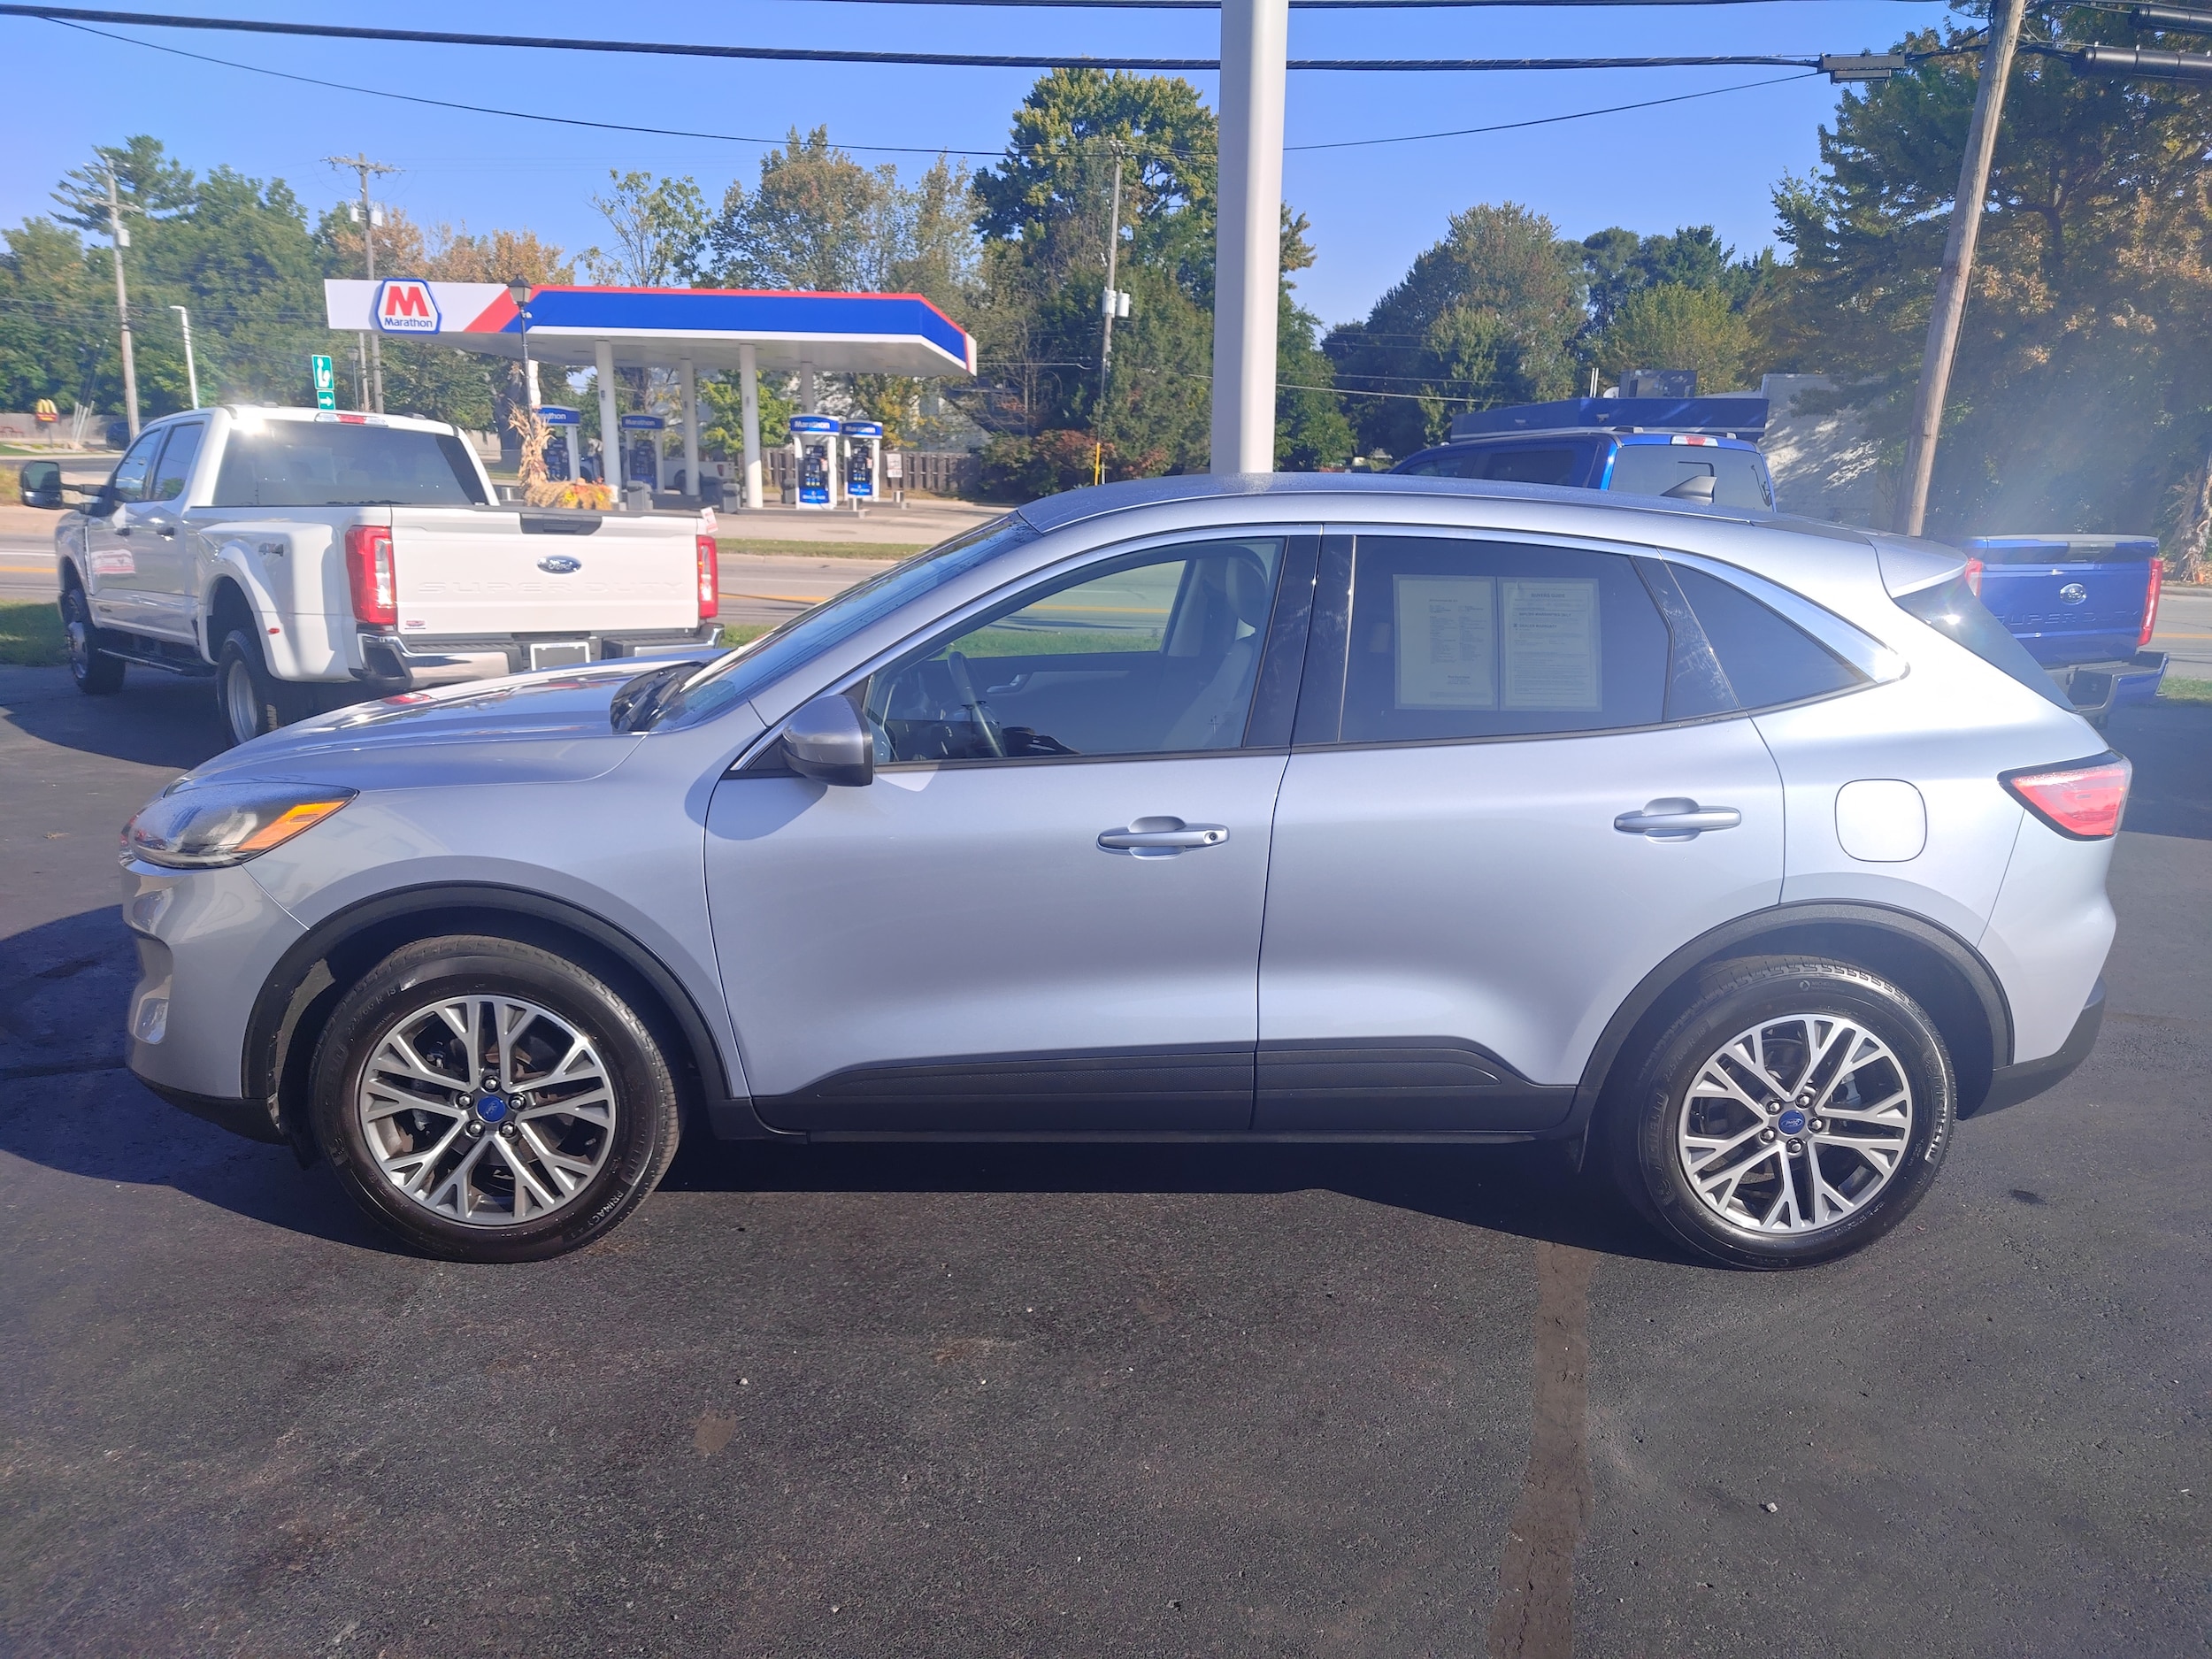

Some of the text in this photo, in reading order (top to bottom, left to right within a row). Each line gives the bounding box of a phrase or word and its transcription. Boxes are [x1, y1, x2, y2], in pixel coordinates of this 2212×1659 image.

[385, 285, 430, 317] M
[384, 317, 434, 328] Marathon
[794, 420, 831, 429] Marathon
[546, 558, 573, 571] Ford
[418, 580, 684, 595] SUPER DUTY
[1925, 1075, 1947, 1161] MICHELIN
